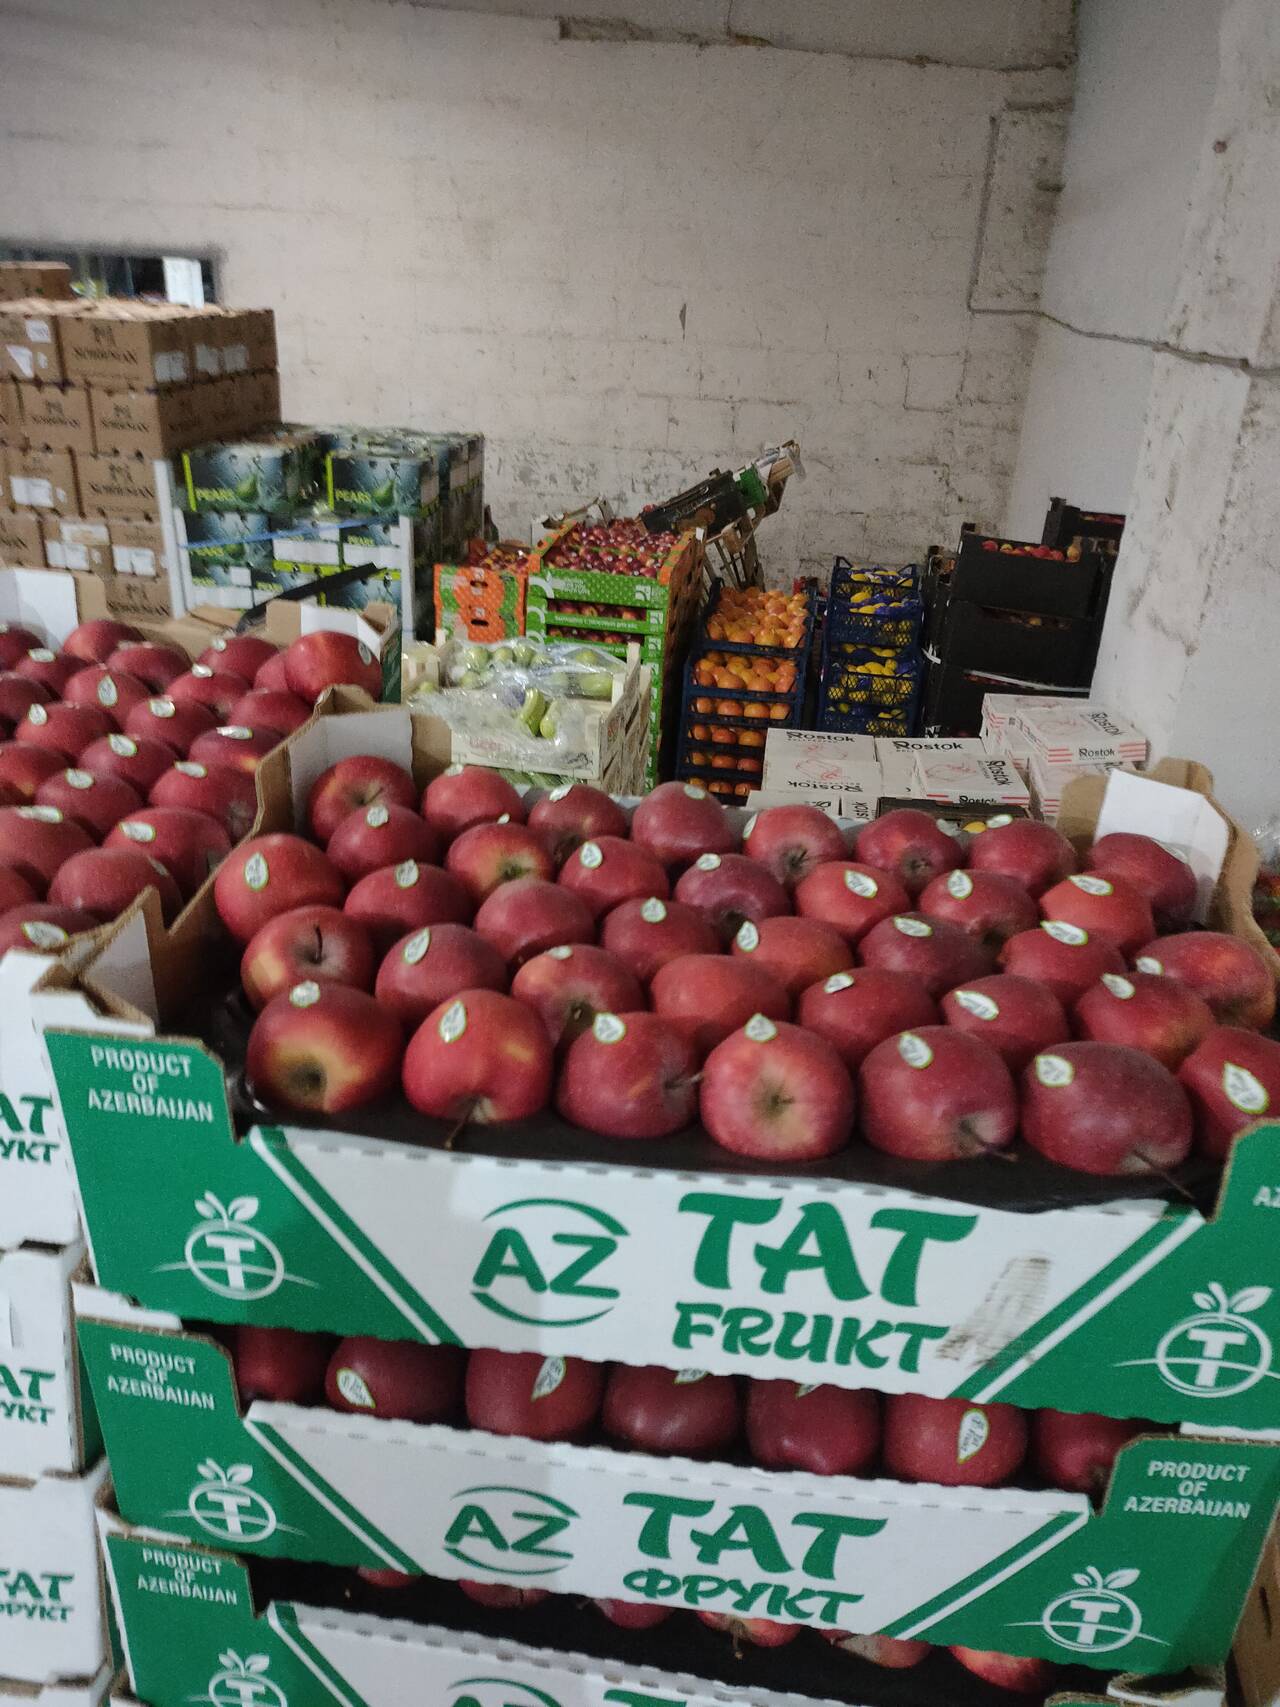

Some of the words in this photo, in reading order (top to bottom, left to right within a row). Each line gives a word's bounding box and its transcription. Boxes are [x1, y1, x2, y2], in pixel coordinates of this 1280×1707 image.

[786, 731, 856, 743] Rostok
[892, 740, 963, 750] Rostok
[1079, 748, 1115, 758] Rostok
[986, 760, 1014, 786] Rostok
[90, 1044, 192, 1079] PRODUCT
[132, 1071, 158, 1095] OF
[88, 1088, 214, 1123] AZERBAIJAN
[472, 1227, 620, 1299] AZ
[677, 1192, 979, 1307] TAT
[671, 1302, 950, 1374] FRUKT
[110, 1343, 196, 1376] PRODUCT
[145, 1365, 168, 1386] OF
[107, 1374, 215, 1411] AZERBAIJAN
[1147, 1460, 1252, 1482] PRODUCT
[1178, 1480, 1208, 1497] OF
[1123, 1496, 1252, 1519] AZERBAIJAN
[444, 1505, 575, 1560] AZ
[142, 1547, 222, 1576] PRODUCT
[174, 1567, 196, 1583] OF
[622, 1568, 865, 1624] ФРУКТ
